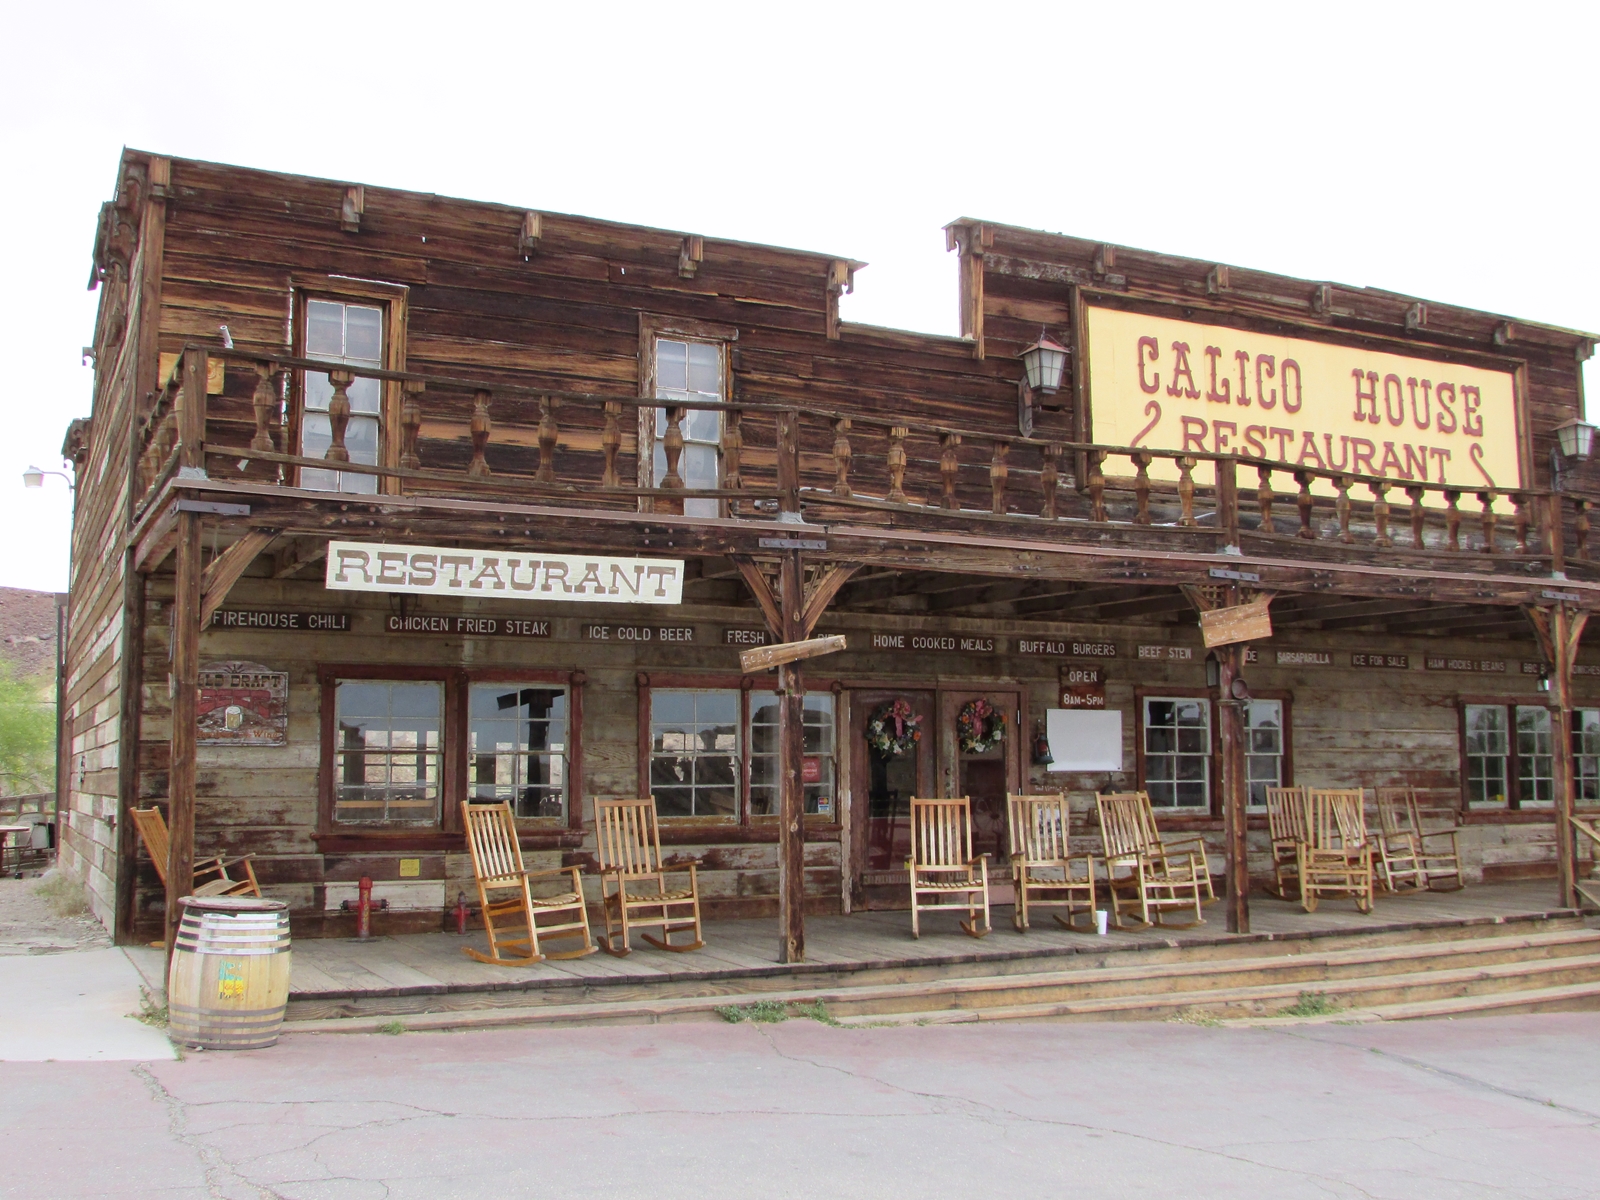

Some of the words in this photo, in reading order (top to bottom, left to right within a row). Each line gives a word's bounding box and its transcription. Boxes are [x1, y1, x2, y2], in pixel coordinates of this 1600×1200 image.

[1137, 336, 1303, 414] CALICO
[1352, 368, 1484, 437] HOUSE
[1181, 415, 1452, 485] RESTAURANT
[335, 549, 677, 597] RESTAURANT
[212, 611, 299, 628] FIREHOUSE
[308, 614, 346, 629] CHILI
[389, 616, 449, 632] CHICKEN
[457, 618, 497, 633] FRIED
[506, 620, 548, 635] STEAK
[589, 625, 610, 640] ICE
[617, 627, 651, 641] COLD
[660, 628, 693, 641] BEER
[727, 630, 765, 644] FRESH
[873, 635, 905, 649] HOME
[912, 637, 955, 650] COOKED
[961, 638, 993, 651] MEALS
[1019, 640, 1065, 654] BUFFALO
[1072, 643, 1116, 656] BURGERS
[1138, 645, 1162, 658] BEEF
[1168, 647, 1191, 659] STEW
[1276, 651, 1330, 664] SARSAPARILLA
[1352, 654, 1366, 665] ICE
[1369, 655, 1384, 666] FOR
[1387, 656, 1406, 667] SALE
[1427, 659, 1445, 669] HAM
[1448, 659, 1472, 670] HOCKS
[1481, 660, 1505, 671] BEANS
[230, 674, 281, 688] DRAFT
[1069, 670, 1098, 682] OPEN
